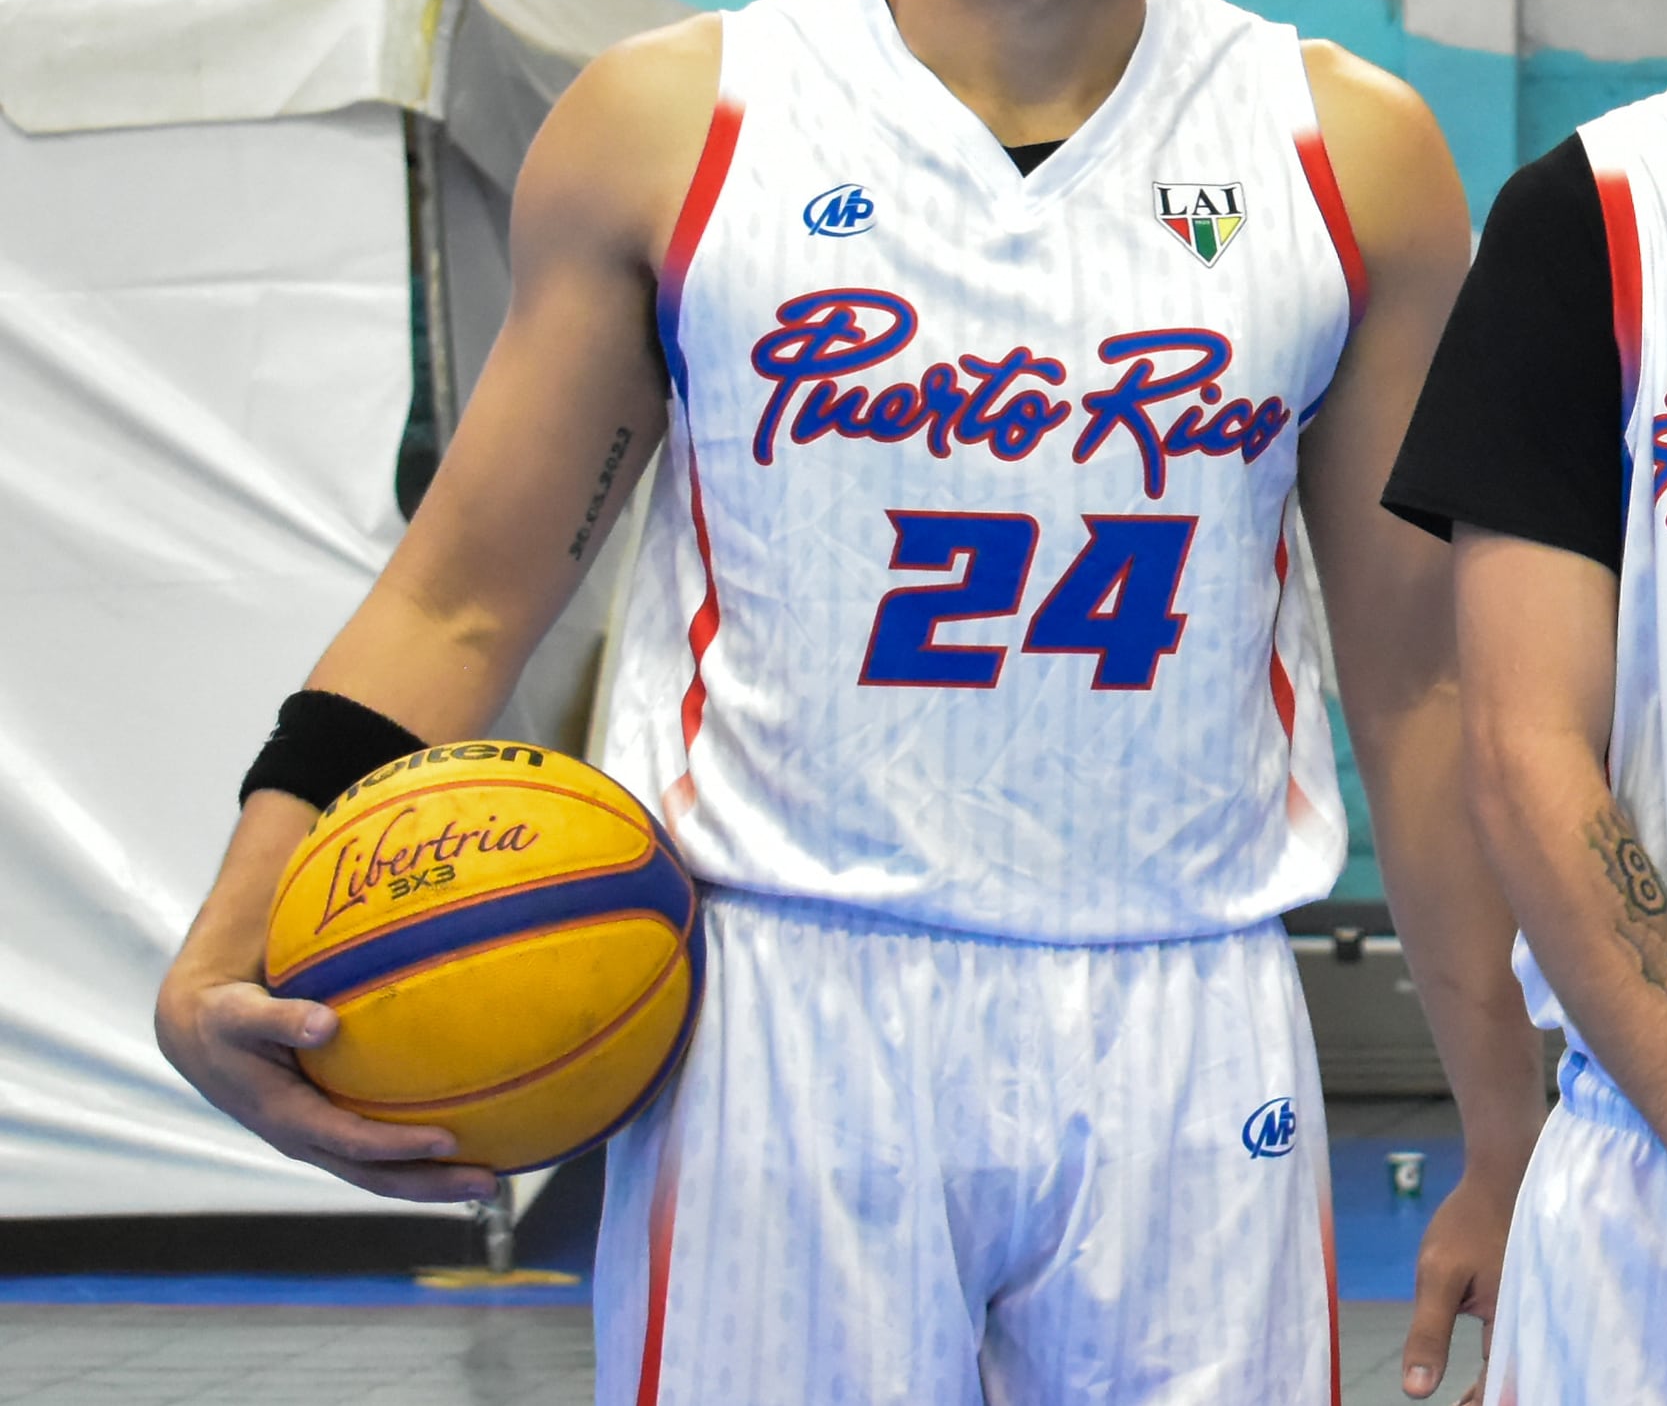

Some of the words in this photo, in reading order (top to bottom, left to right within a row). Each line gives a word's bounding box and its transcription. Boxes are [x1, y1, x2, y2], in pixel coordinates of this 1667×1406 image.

[1157, 186, 1243, 216] LAI
[751, 287, 1073, 467] Puerto
[1072, 327, 1290, 499] Rico
[857, 509, 1199, 690] 24
[315, 807, 540, 936] Libertria
[388, 864, 457, 901] 3X3
